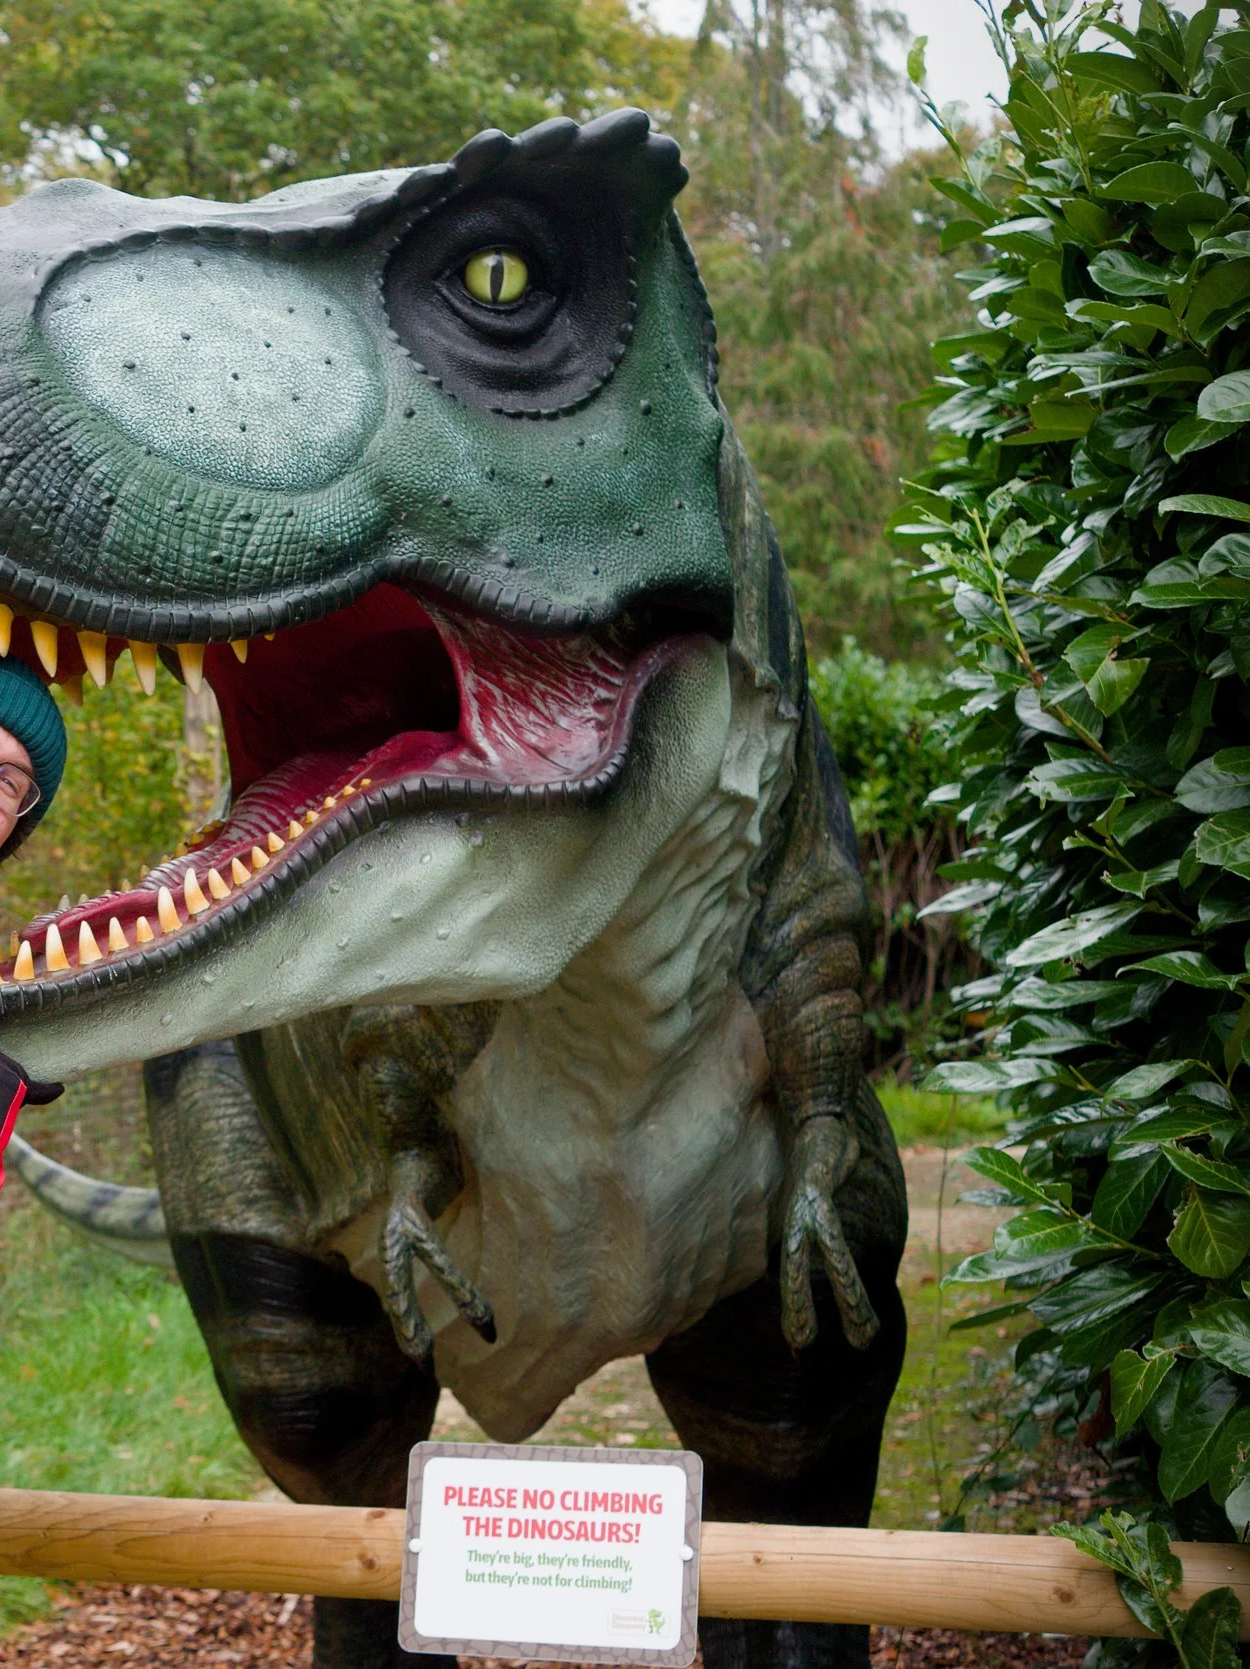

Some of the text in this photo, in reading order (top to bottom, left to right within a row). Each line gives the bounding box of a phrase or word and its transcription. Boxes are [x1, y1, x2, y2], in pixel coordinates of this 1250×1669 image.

[444, 1486, 663, 1515] PLEASE NO CLIMBING
[463, 1516, 641, 1543] THE DINOSAURS!
[467, 1549, 633, 1572] They're big, they're friendly,
[465, 1569, 633, 1593] but they're not for climbing!
